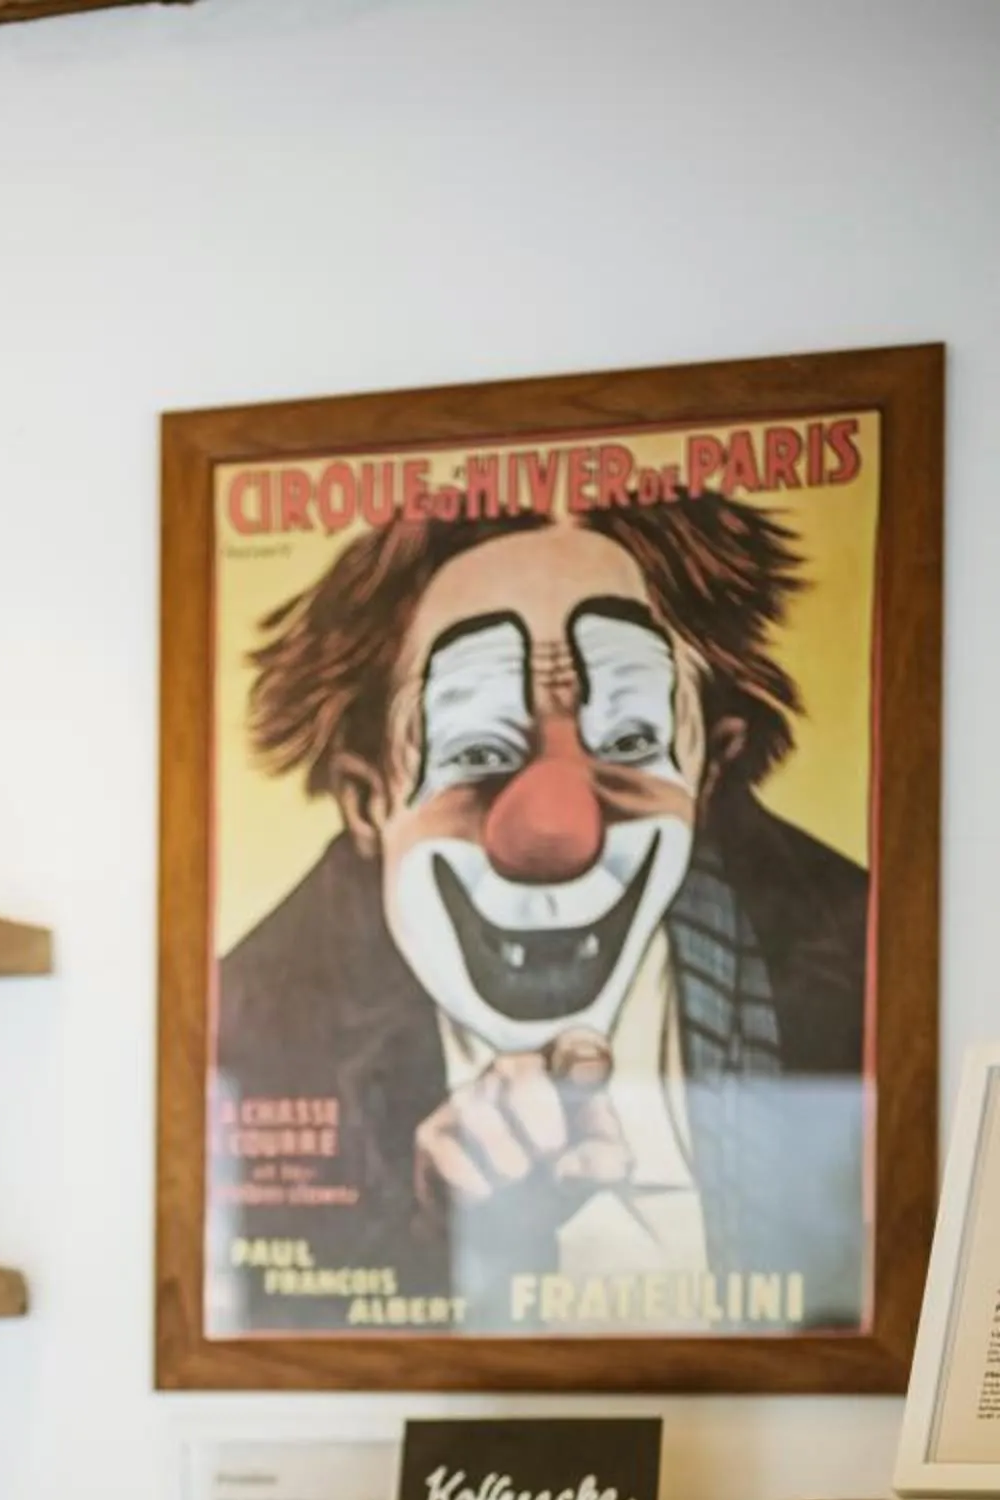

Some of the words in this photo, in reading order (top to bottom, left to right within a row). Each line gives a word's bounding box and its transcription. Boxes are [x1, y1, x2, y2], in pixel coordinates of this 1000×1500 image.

[228, 456, 430, 537] CIRQUE
[638, 465, 681, 503] DE
[687, 418, 861, 501] PARIS
[231, 1237, 314, 1268] PAUL
[348, 1297, 467, 1325] ALBERT
[511, 1272, 804, 1322] FRATELLINI
